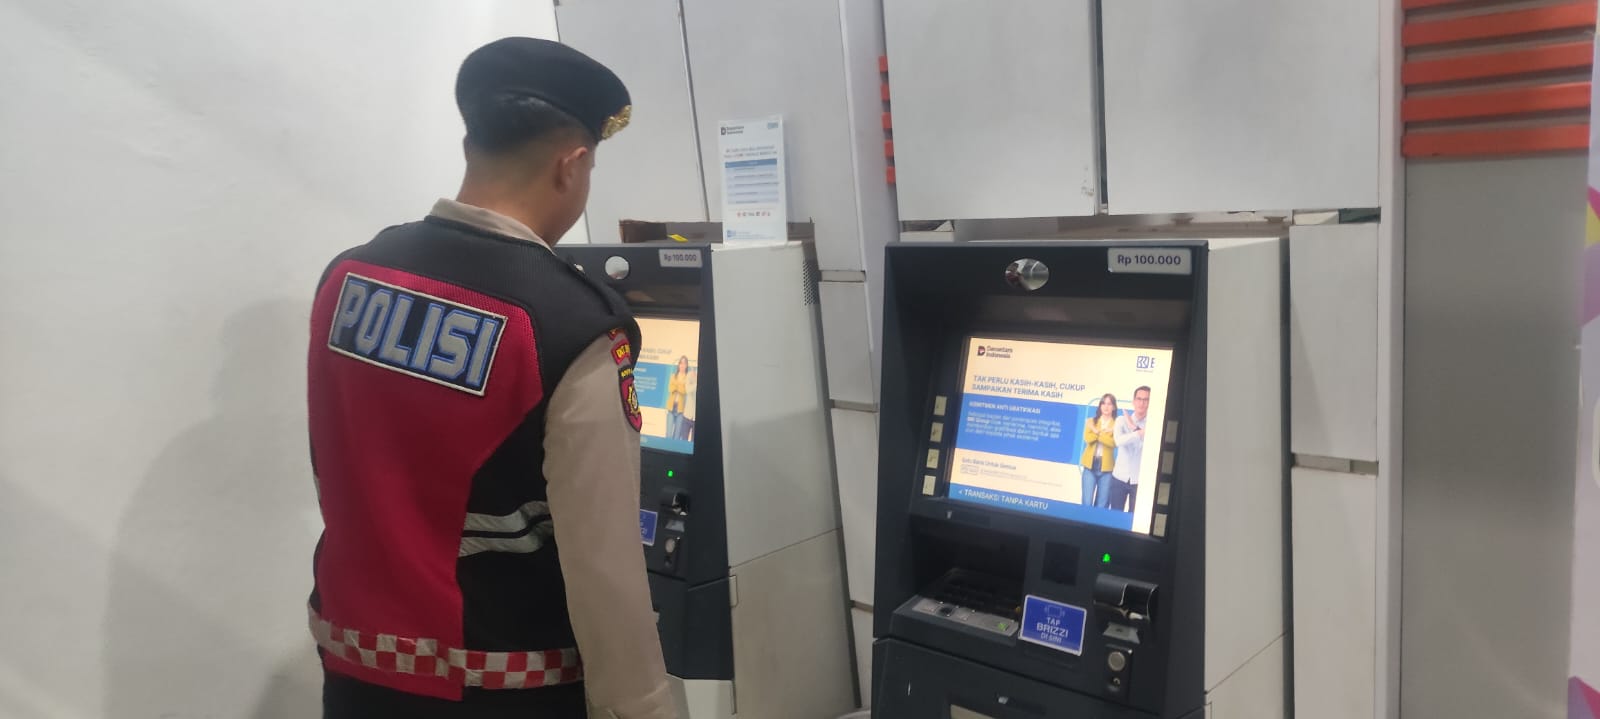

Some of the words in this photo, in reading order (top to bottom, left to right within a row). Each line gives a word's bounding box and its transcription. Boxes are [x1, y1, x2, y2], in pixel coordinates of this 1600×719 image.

[1117, 254, 1132, 267] Rp
[1134, 254, 1182, 265] 100.000
[332, 280, 499, 387] POLISI
[972, 383, 1014, 394] SAMPAIKAN
[1014, 388, 1040, 397] TERIMA
[1040, 390, 1063, 399] KASIH
[973, 375, 987, 383] TAK
[988, 376, 1009, 385] PERLU
[1059, 383, 1086, 392] CUKUP
[1001, 495, 1024, 504] TANPA
[1025, 500, 1049, 510] KARTU
[1046, 616, 1061, 626] TAP
[1036, 622, 1069, 638] BRIZZI
